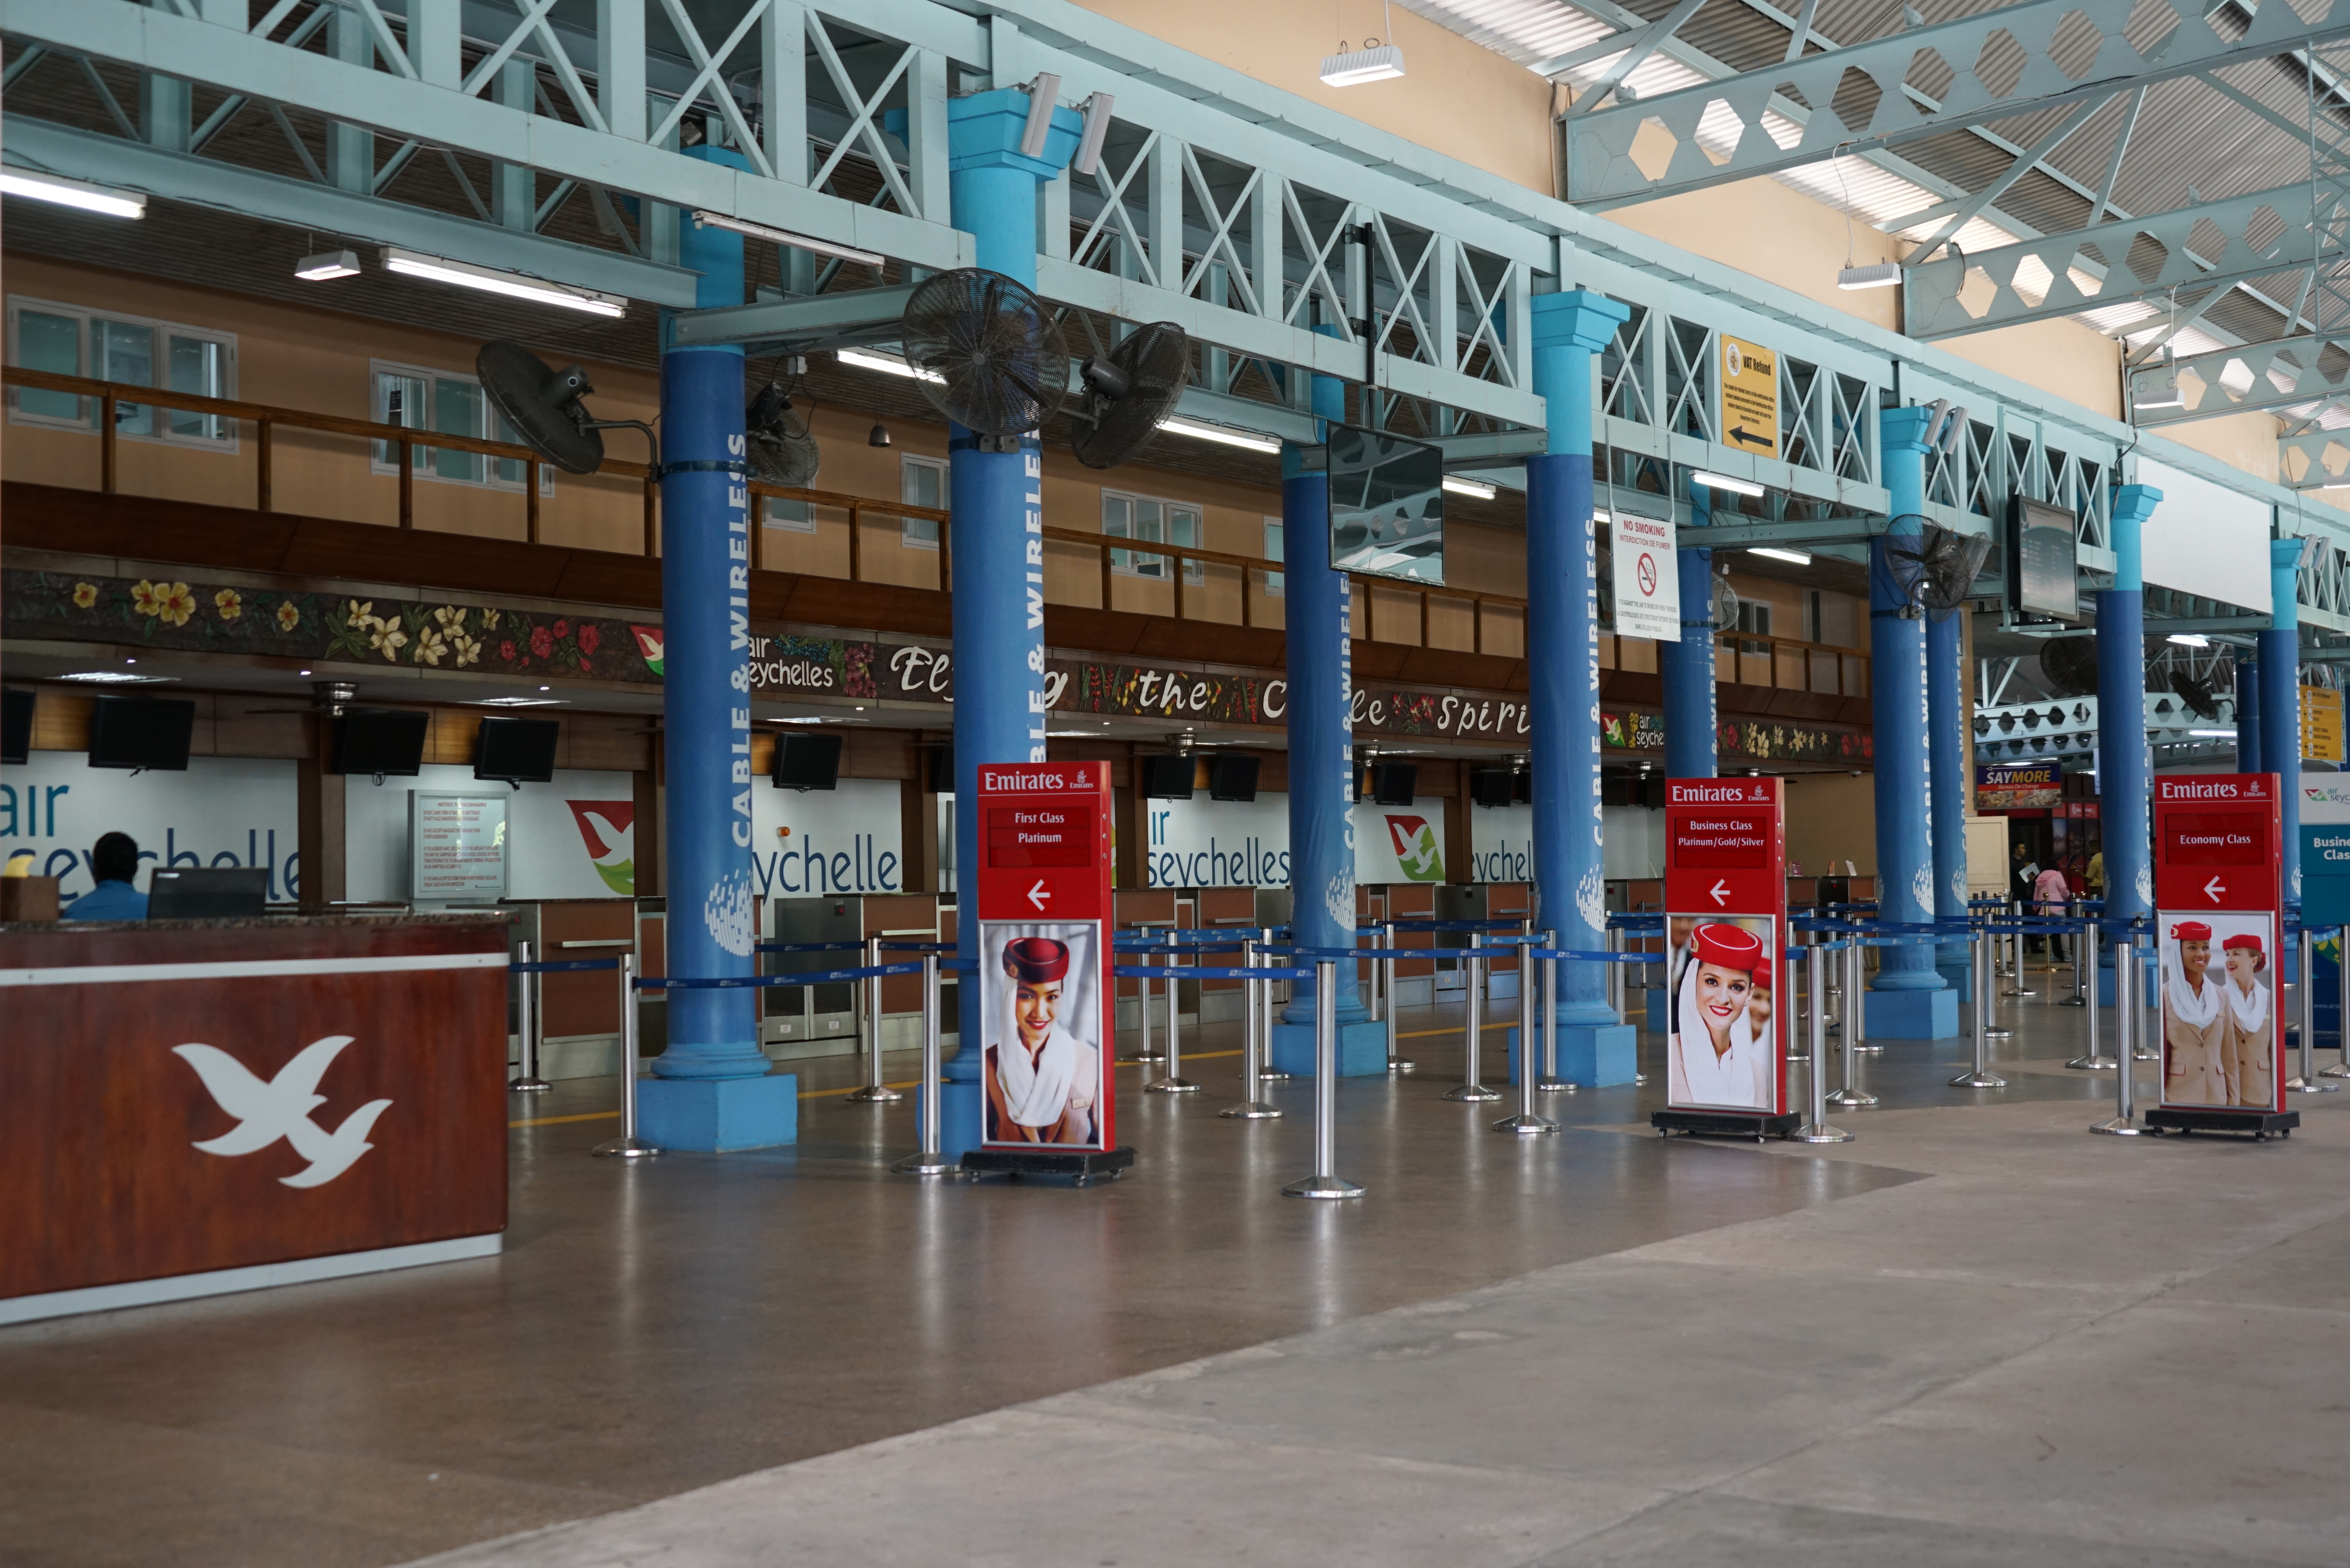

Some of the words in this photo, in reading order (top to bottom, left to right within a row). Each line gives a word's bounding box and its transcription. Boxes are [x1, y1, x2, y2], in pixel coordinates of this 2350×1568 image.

[1743, 355, 1752, 370] VAT
[1753, 359, 1771, 376] Refund
[1623, 520, 1633, 531] NO
[1635, 522, 1665, 538] SMOKING
[1619, 534, 1648, 547] INTERDICTION
[1656, 542, 1670, 550] FUMER
[1586, 518, 1600, 691] WIRELESS
[1340, 572, 1352, 702] WIRELE
[749, 637, 770, 658] air
[1028, 643, 1045, 675] &
[731, 664, 750, 693] &
[1139, 670, 1207, 710] the
[1591, 700, 1600, 724] &
[1639, 715, 1650, 729] air
[1343, 711, 1352, 734] &
[731, 708, 751, 847] CABLE
[984, 771, 1064, 790] Emirates
[1986, 770, 2051, 785] SAYMORE
[1344, 744, 1354, 849] CABLE
[1592, 736, 1603, 846] CABLE
[1672, 785, 1742, 802] Emirates
[2161, 781, 2238, 798] Emirates
[2330, 794, 2350, 803] seyc
[1015, 813, 1037, 823] First
[1039, 812, 1065, 823] Class
[1690, 821, 1727, 830] Business
[1730, 821, 1752, 830] Class
[1018, 833, 1062, 843] Platinum
[1678, 837, 1764, 848] Platinum/Gold/Silver
[2180, 834, 2224, 846] Economy
[2227, 834, 2251, 844] Class
[2314, 836, 2350, 848] Busine
[752, 834, 903, 906] ychelle
[1148, 837, 1290, 887] seychelles
